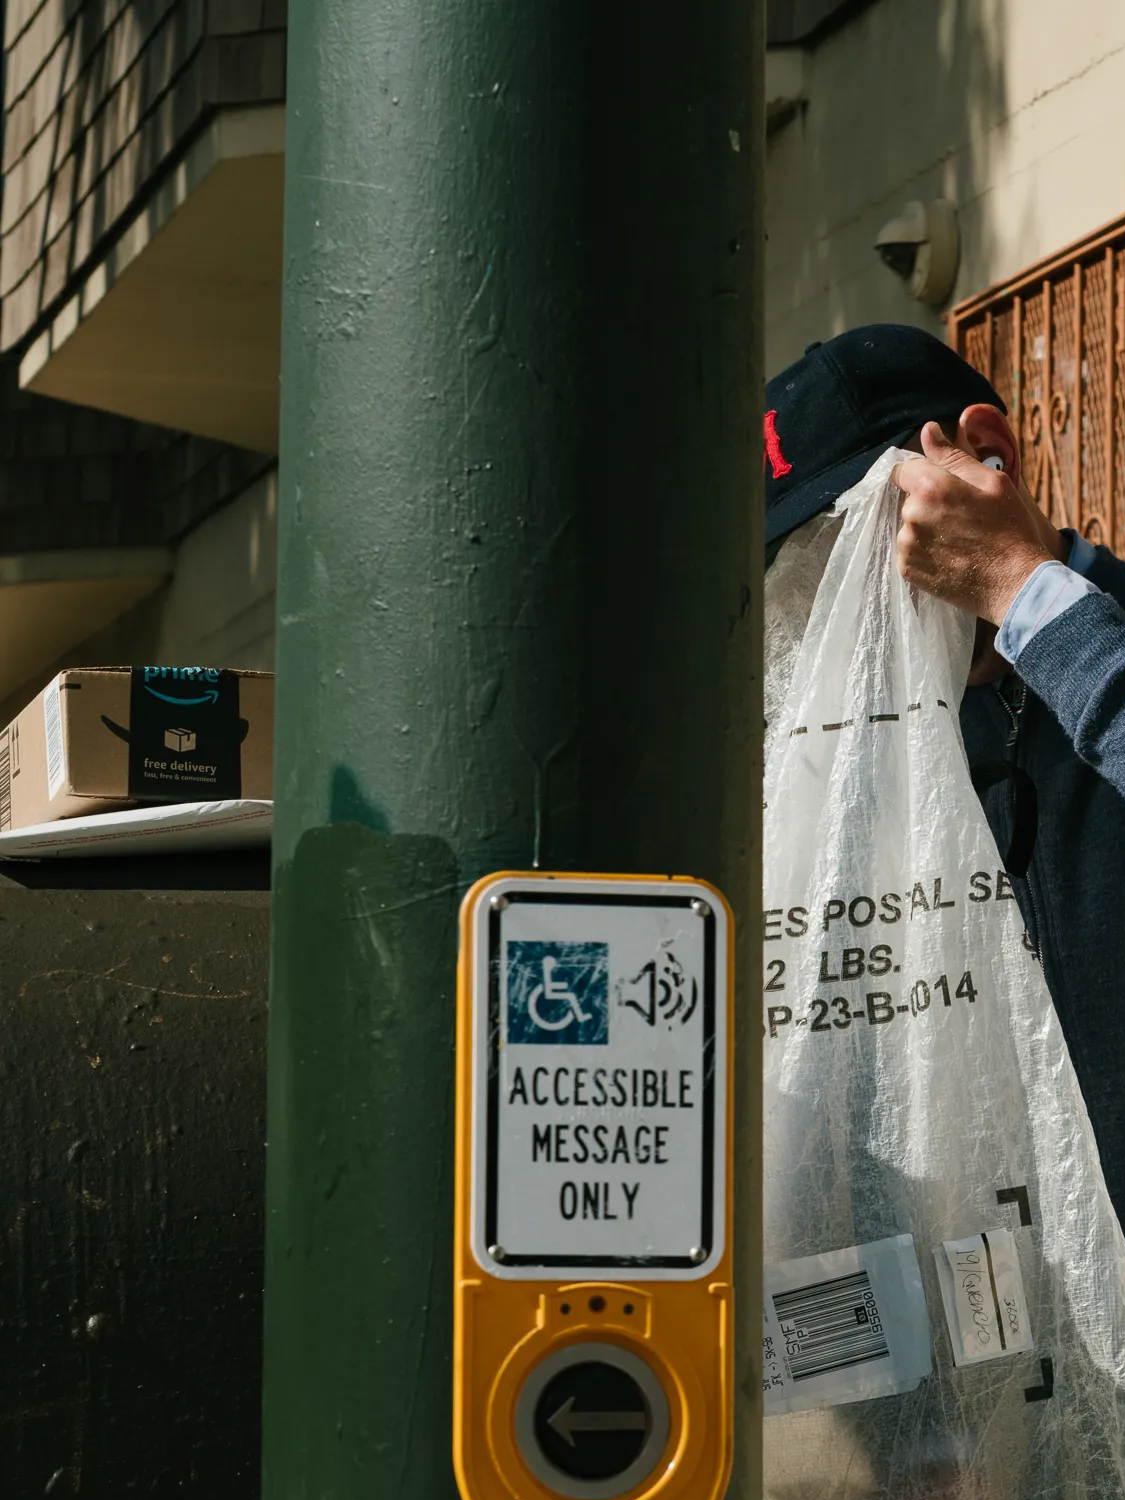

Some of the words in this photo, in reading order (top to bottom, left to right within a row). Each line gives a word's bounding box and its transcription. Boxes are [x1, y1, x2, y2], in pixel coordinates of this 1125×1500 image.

[144, 758, 167, 770] free
[170, 760, 217, 775] delivery
[144, 771, 159, 779] fast,
[181, 775, 217, 783] convenient
[822, 877, 955, 933] POSAL
[818, 944, 901, 984] LBS.
[509, 1066, 694, 1109] ACCESSIBLE
[532, 1123, 669, 1165] MESSAGE
[559, 1181, 641, 1221] ONLY
[862, 1290, 883, 1334] 95600
[780, 1323, 800, 1356] SMF
[797, 1329, 808, 1339] P
